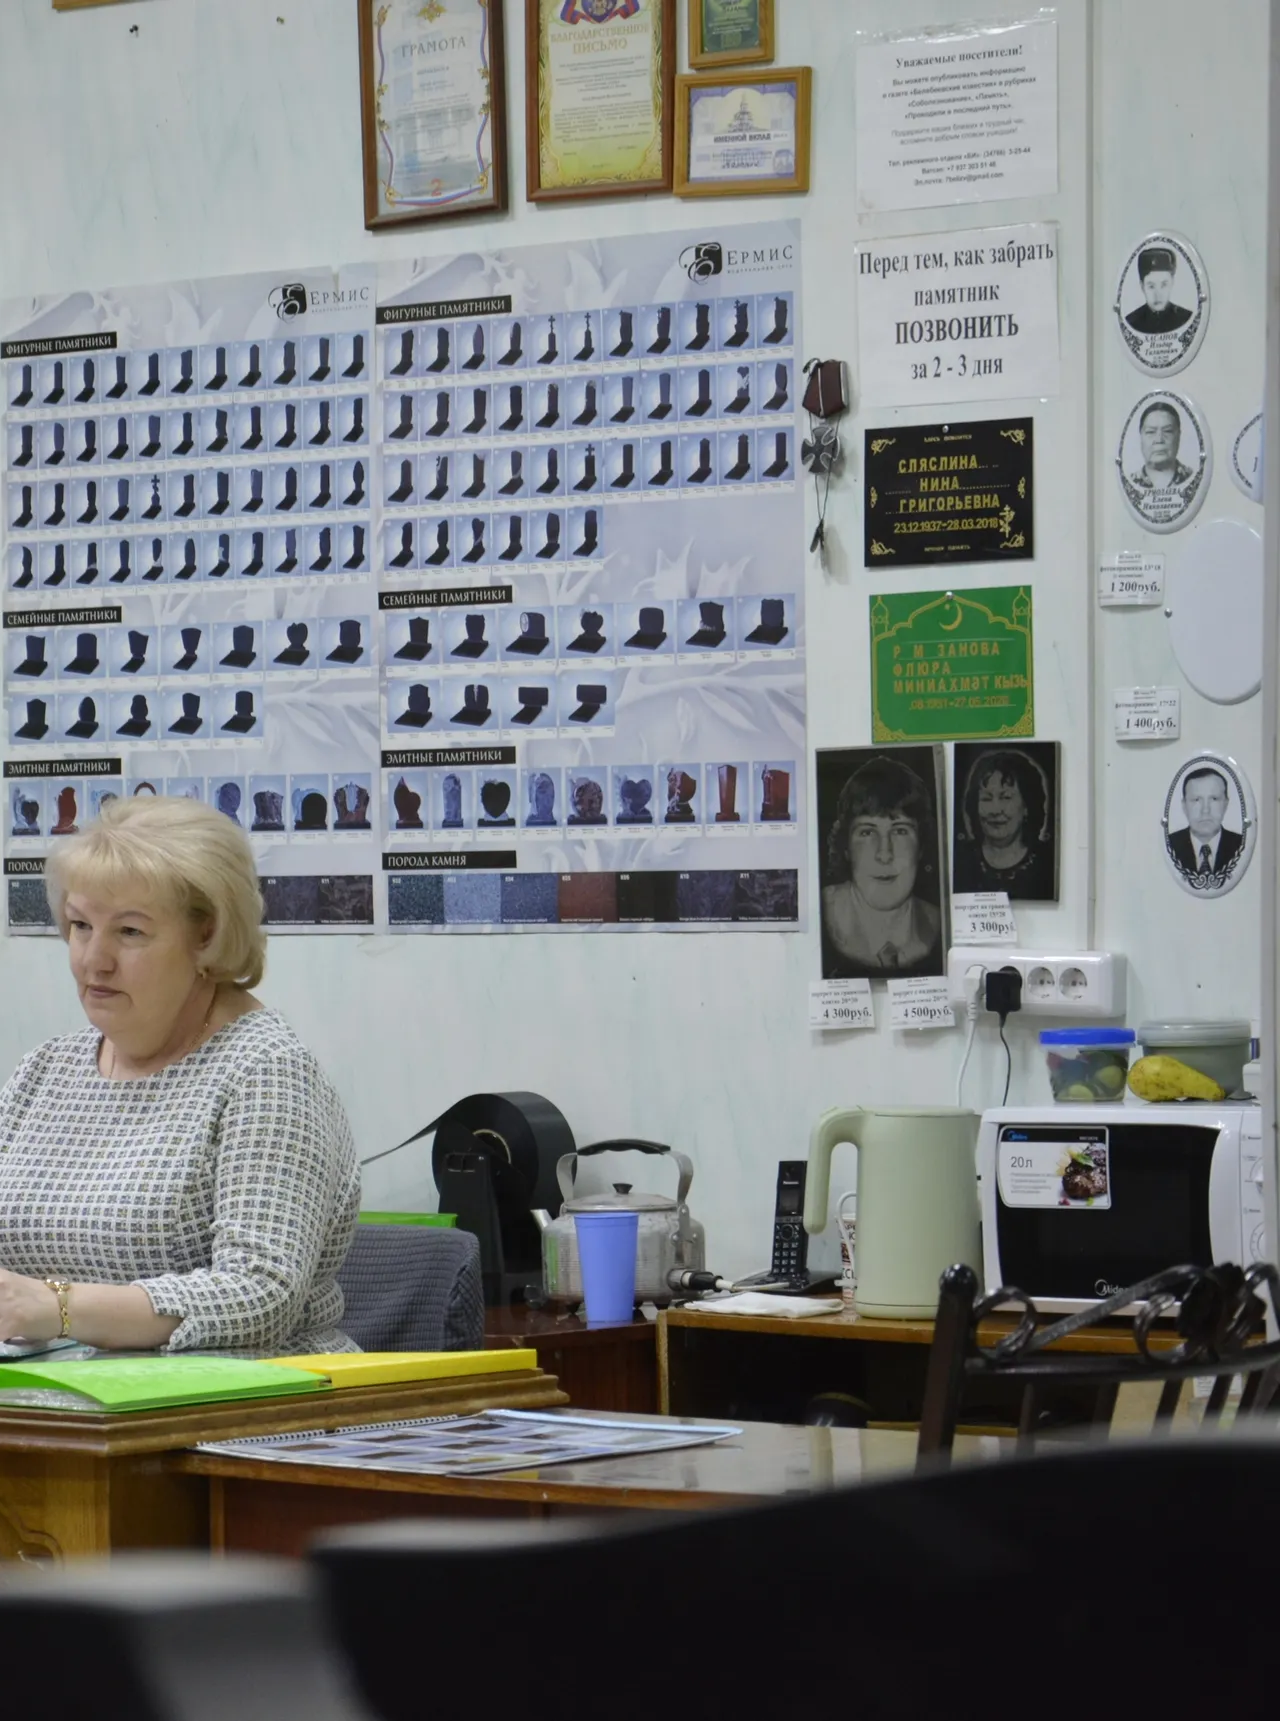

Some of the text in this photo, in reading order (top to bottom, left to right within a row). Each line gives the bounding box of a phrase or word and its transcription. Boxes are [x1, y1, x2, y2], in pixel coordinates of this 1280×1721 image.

[401, 36, 466, 58] ГРАМОТА
[573, 38, 628, 54] ПИСЬМО
[896, 45, 1023, 68] Уважаемые посетители!
[727, 245, 793, 265] ЕРМИС
[859, 240, 1054, 279] Перед тем, как забрать
[310, 287, 369, 305] ЕРМИС
[914, 285, 1000, 306] памятник
[384, 305, 436, 320] ФИГУРНЫЕ
[439, 300, 505, 315] ПАМЯТНИКИ
[895, 314, 1019, 345] ПОЗВОНИТЬ
[6, 336, 111, 355] ФИГУРНЫЕ ПАМЯТНИКИ
[911, 363, 928, 380] за
[933, 356, 942, 378] 2
[958, 354, 967, 377] 3
[972, 358, 1003, 377] дня
[920, 476, 959, 492] НИНА
[899, 494, 1000, 513] ГРИГОРЬЕВНА
[383, 590, 506, 606] СЕМЕЙНЫЕ ПАМЯТНИКИ
[7, 610, 117, 625] СЕМЕЙНЫЕ ПАМЯТНИКИ
[893, 662, 952, 677] ФЛЮРА
[386, 750, 502, 764] ЭЛИТНЫЕ ПАМЯТНИКИ
[8, 761, 111, 774] ЭЛИТНЫЕ ПАМЯТНИКИ
[8, 861, 45, 872] ПОРОДА
[388, 855, 467, 867] ПОРОДА КАМНЯ
[832, 1007, 872, 1020] 300руб.
[911, 1005, 952, 1019] 500руб.
[1095, 1279, 1129, 1297] Mide
